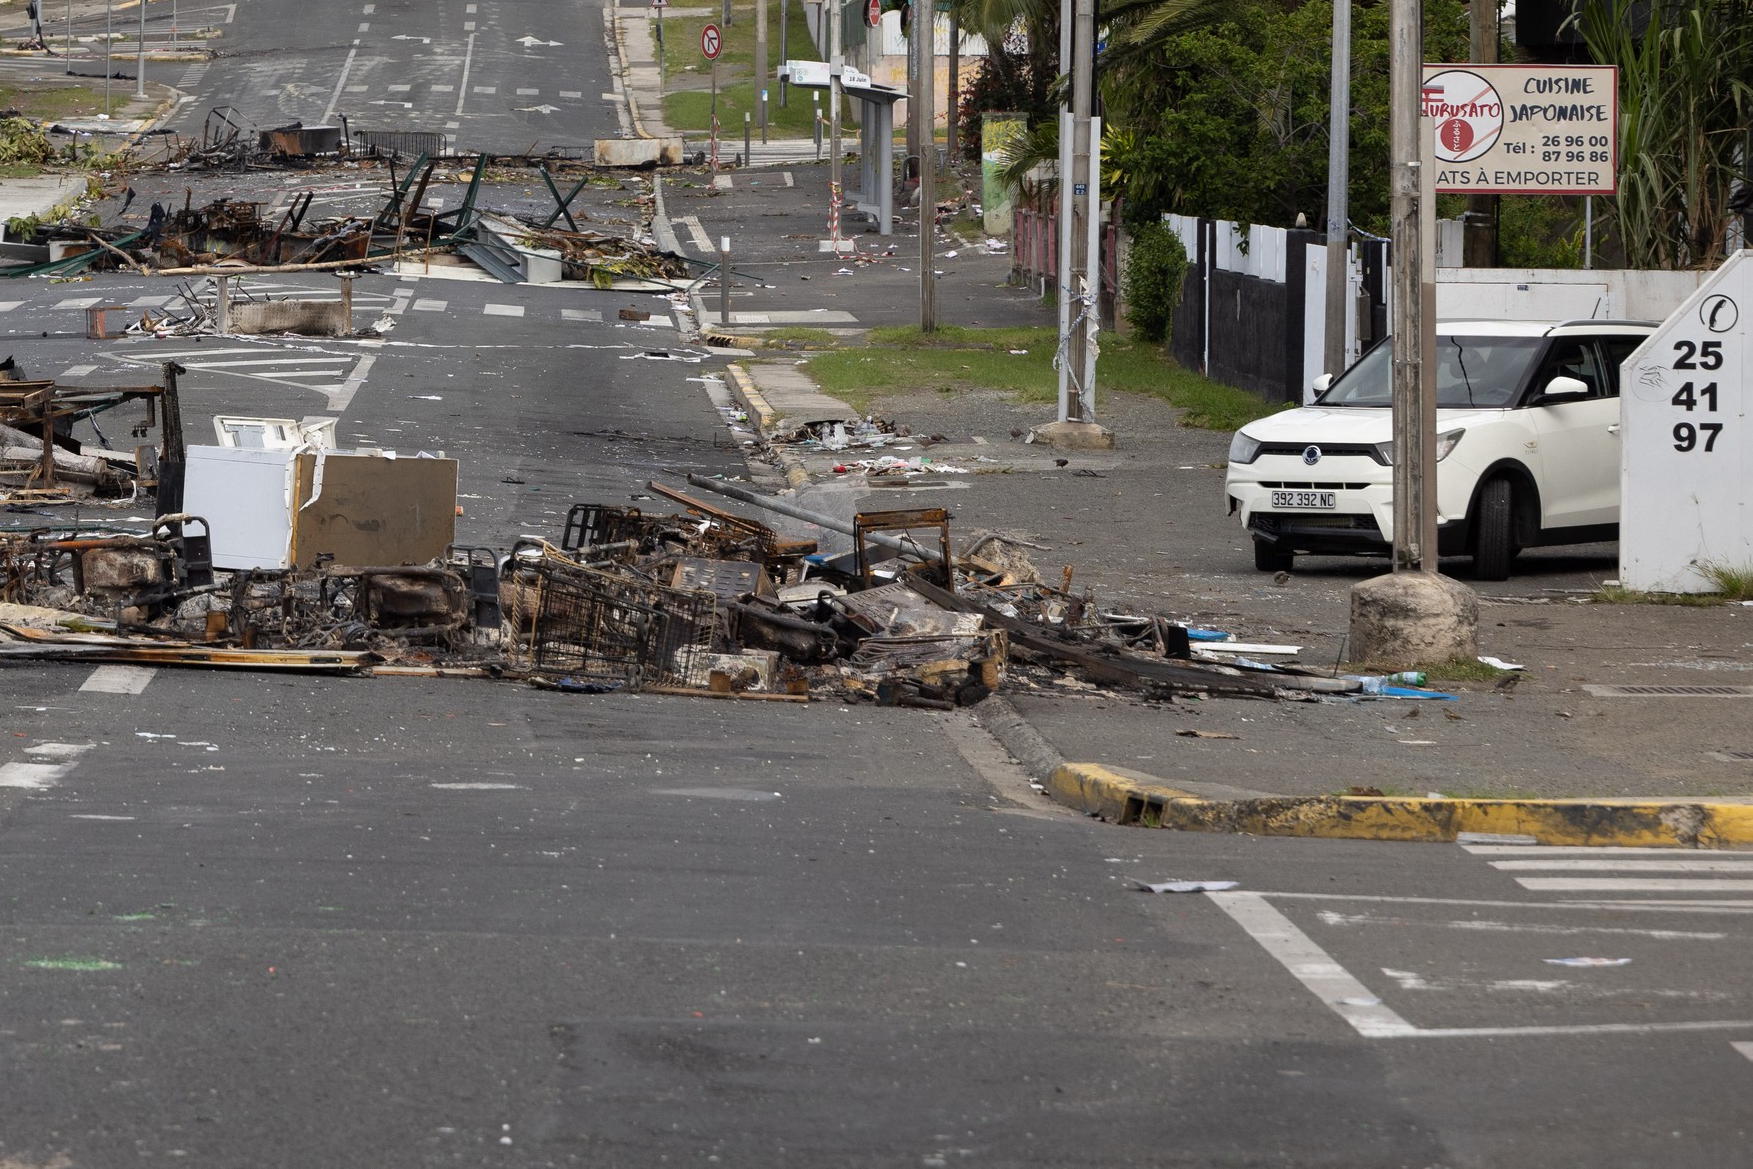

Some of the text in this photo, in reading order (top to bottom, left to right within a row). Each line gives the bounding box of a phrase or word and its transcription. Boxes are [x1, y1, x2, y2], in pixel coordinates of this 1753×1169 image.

[1523, 77, 1595, 95] CUISINE
[1509, 103, 1608, 123] JAPONAISE
[1504, 141, 1526, 154] Tél
[1542, 135, 1608, 147] 26 96 00
[1542, 150, 1608, 162] 87 96 86
[1436, 167, 1600, 186] ATS À EMPORTER
[1672, 340, 1724, 371] 25
[1671, 381, 1718, 412] 41
[1672, 422, 1724, 453] 97
[1273, 492, 1334, 507] 392 392 NC
